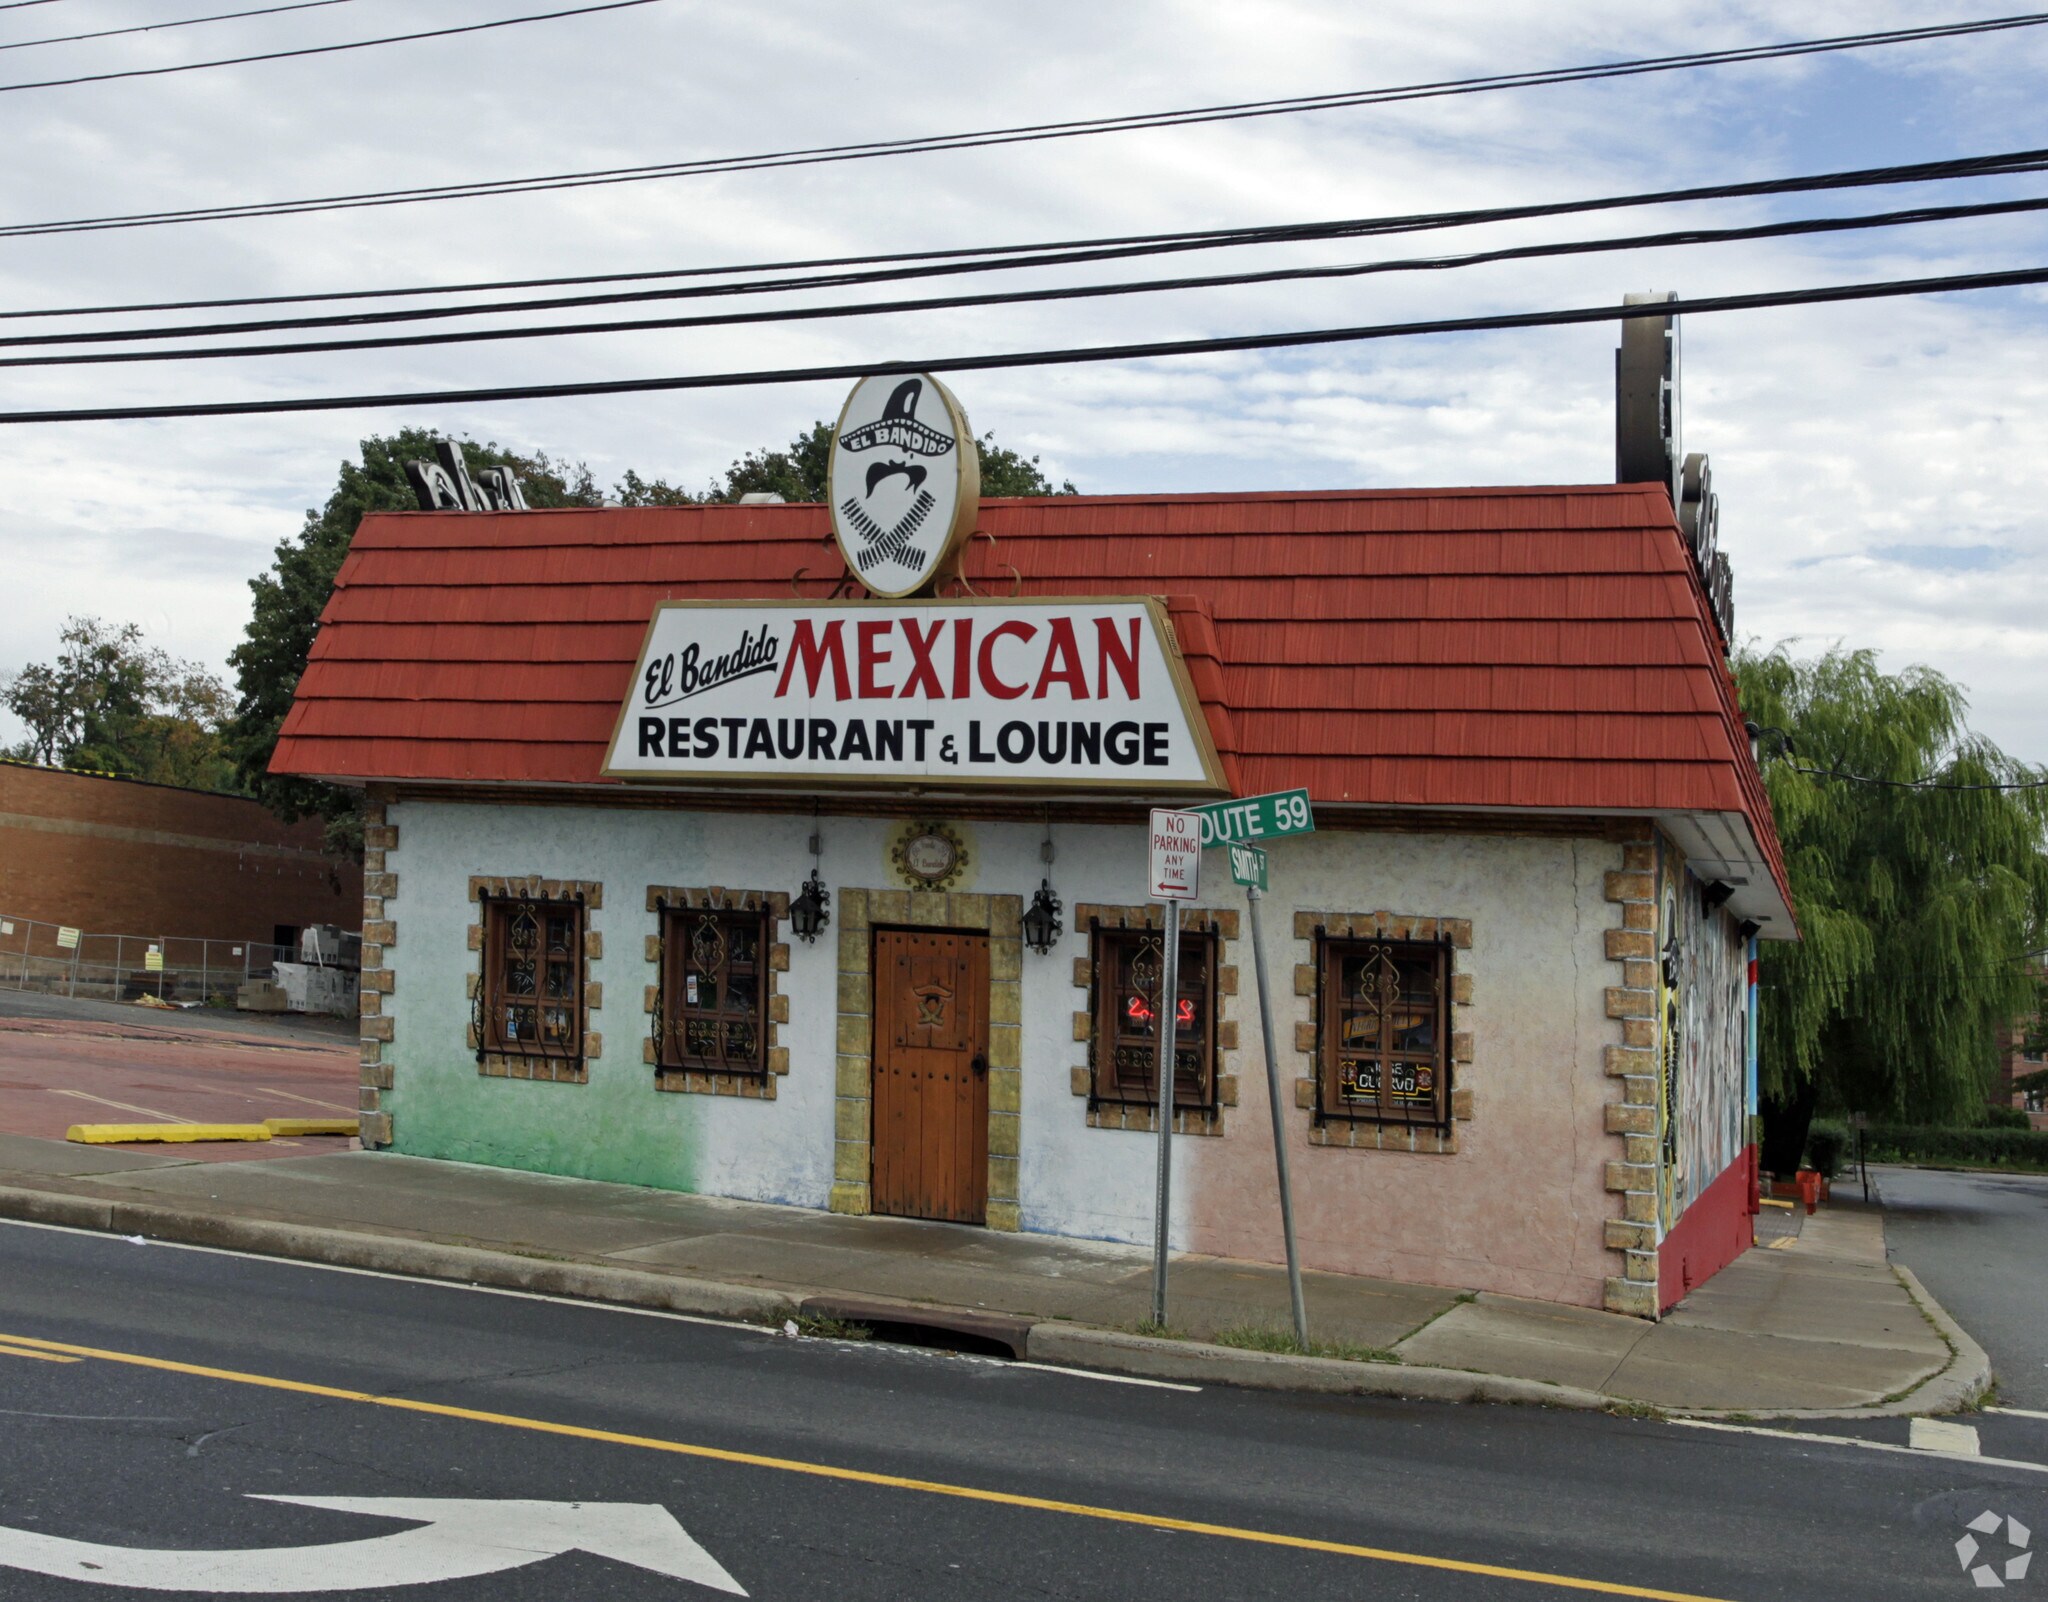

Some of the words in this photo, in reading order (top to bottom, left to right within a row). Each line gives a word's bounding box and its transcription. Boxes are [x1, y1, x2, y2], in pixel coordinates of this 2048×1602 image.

[850, 435, 871, 450] EL
[875, 427, 947, 453] BANDIDO
[645, 653, 674, 704] El
[681, 624, 779, 693] Bandido
[774, 617, 1141, 701] MEXICAN
[639, 717, 934, 764] RESTAURANT
[939, 735, 958, 764] &
[969, 720, 1169, 766] LOUNGE
[1166, 817, 1185, 834] NO
[1201, 803, 1264, 844] OUTE
[1275, 796, 1308, 831] 59
[1154, 834, 1196, 853] PARKING
[1164, 868, 1185, 880] TIME
[1165, 855, 1184, 867] ANY
[1231, 846, 1259, 882] SMITH
